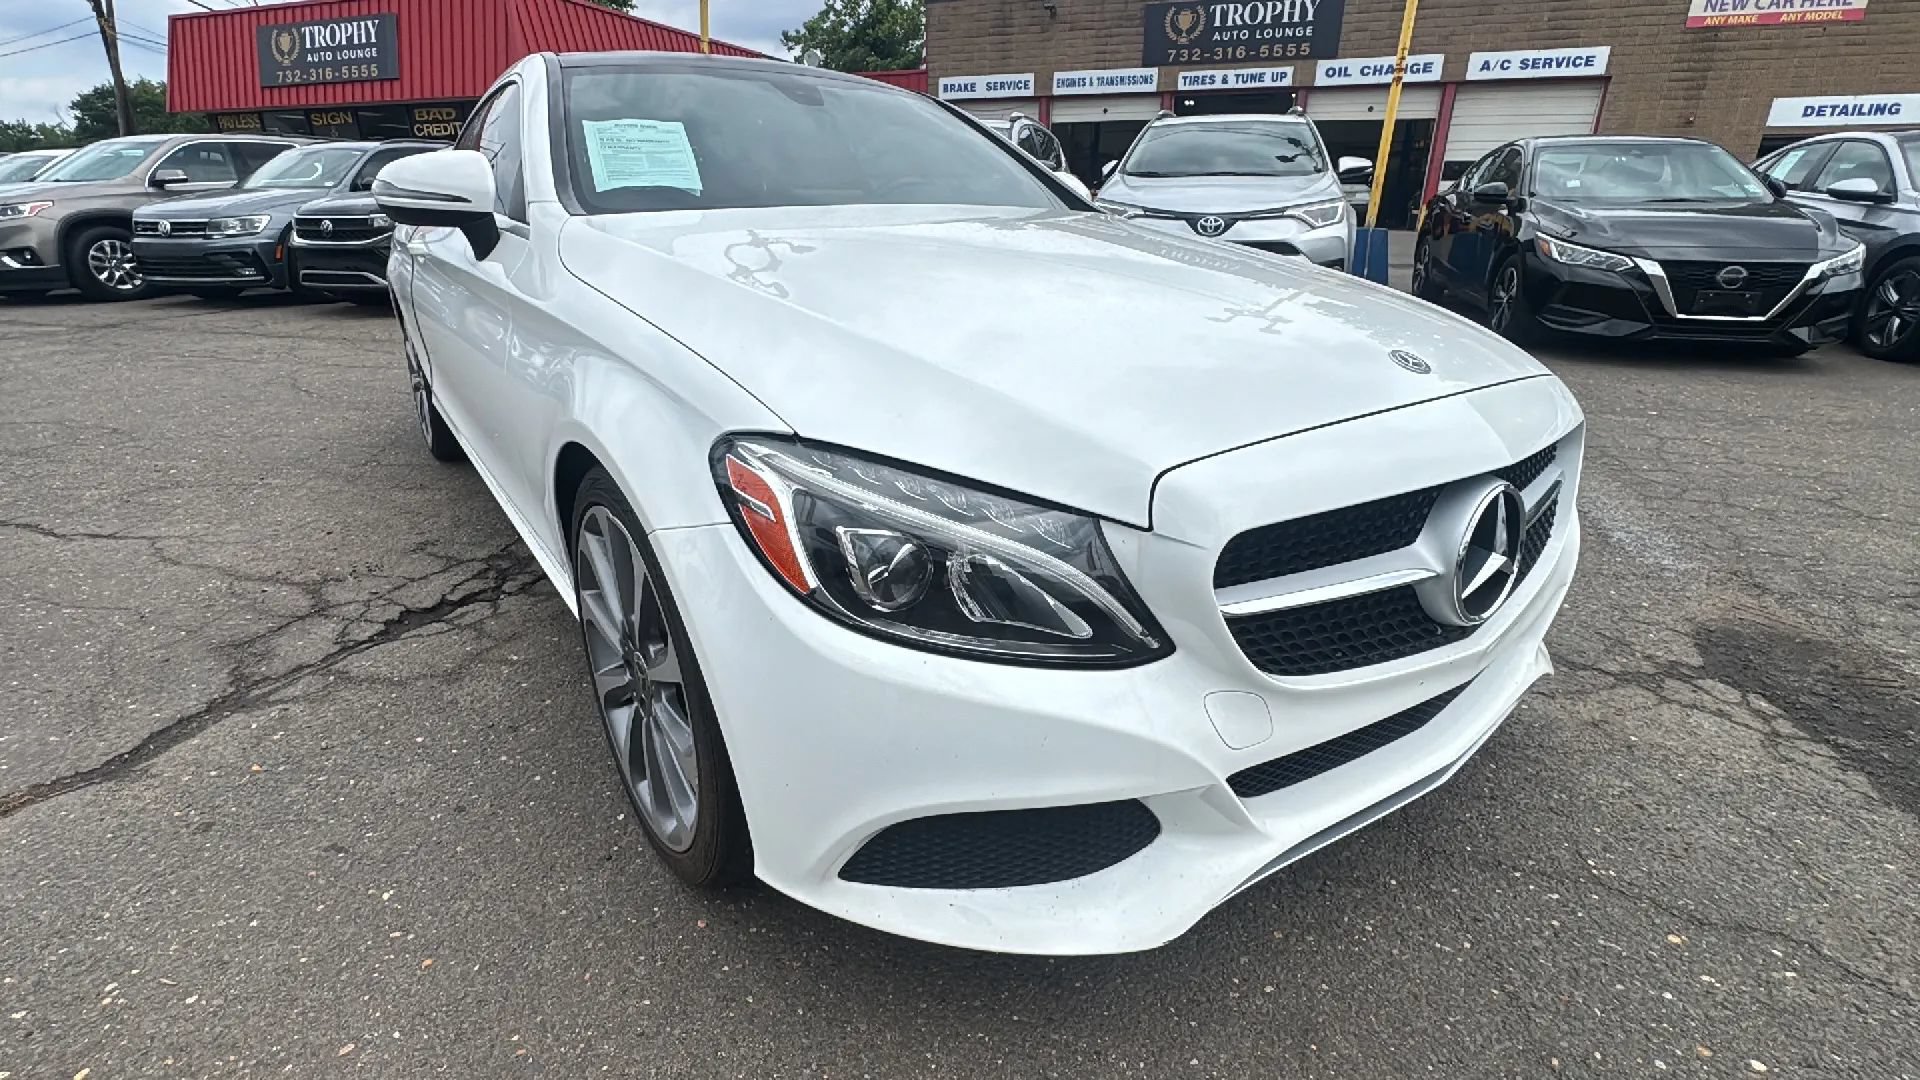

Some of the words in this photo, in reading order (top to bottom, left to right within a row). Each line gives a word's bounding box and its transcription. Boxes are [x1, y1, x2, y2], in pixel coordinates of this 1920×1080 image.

[1209, 0, 1320, 26] TROPHY
[1703, 16, 1727, 25] ANY
[1728, 14, 1759, 24] MAKE
[1780, 13, 1804, 22] ANY
[1804, 10, 1843, 21] MODEL
[301, 19, 379, 49] TROPHY
[1212, 29, 1249, 41] AUTO
[1255, 26, 1313, 39] LOUNGE
[306, 51, 332, 62] AUTO
[337, 48, 378, 60] LOUNGE
[1167, 43, 1310, 62] 732-316-5555
[1478, 59, 1512, 72] A/C
[1518, 55, 1596, 71] SERVICE
[276, 63, 378, 83] 732-316-5555
[1181, 74, 1216, 87] TIRES
[1221, 74, 1228, 85] &
[1234, 72, 1266, 84] TUNE
[1271, 71, 1288, 82] UP
[1325, 66, 1352, 78] OIL
[943, 82, 977, 93] BRAKE
[985, 80, 1031, 92] SERVICE
[1056, 77, 1086, 88] ENGINES
[1089, 76, 1094, 87] &
[1096, 74, 1154, 87] TRANSMISSIONS
[414, 107, 456, 121] BAD
[1801, 102, 1902, 118] DETAILING
[311, 111, 353, 126] SIGN
[413, 121, 462, 137] CREDIT
